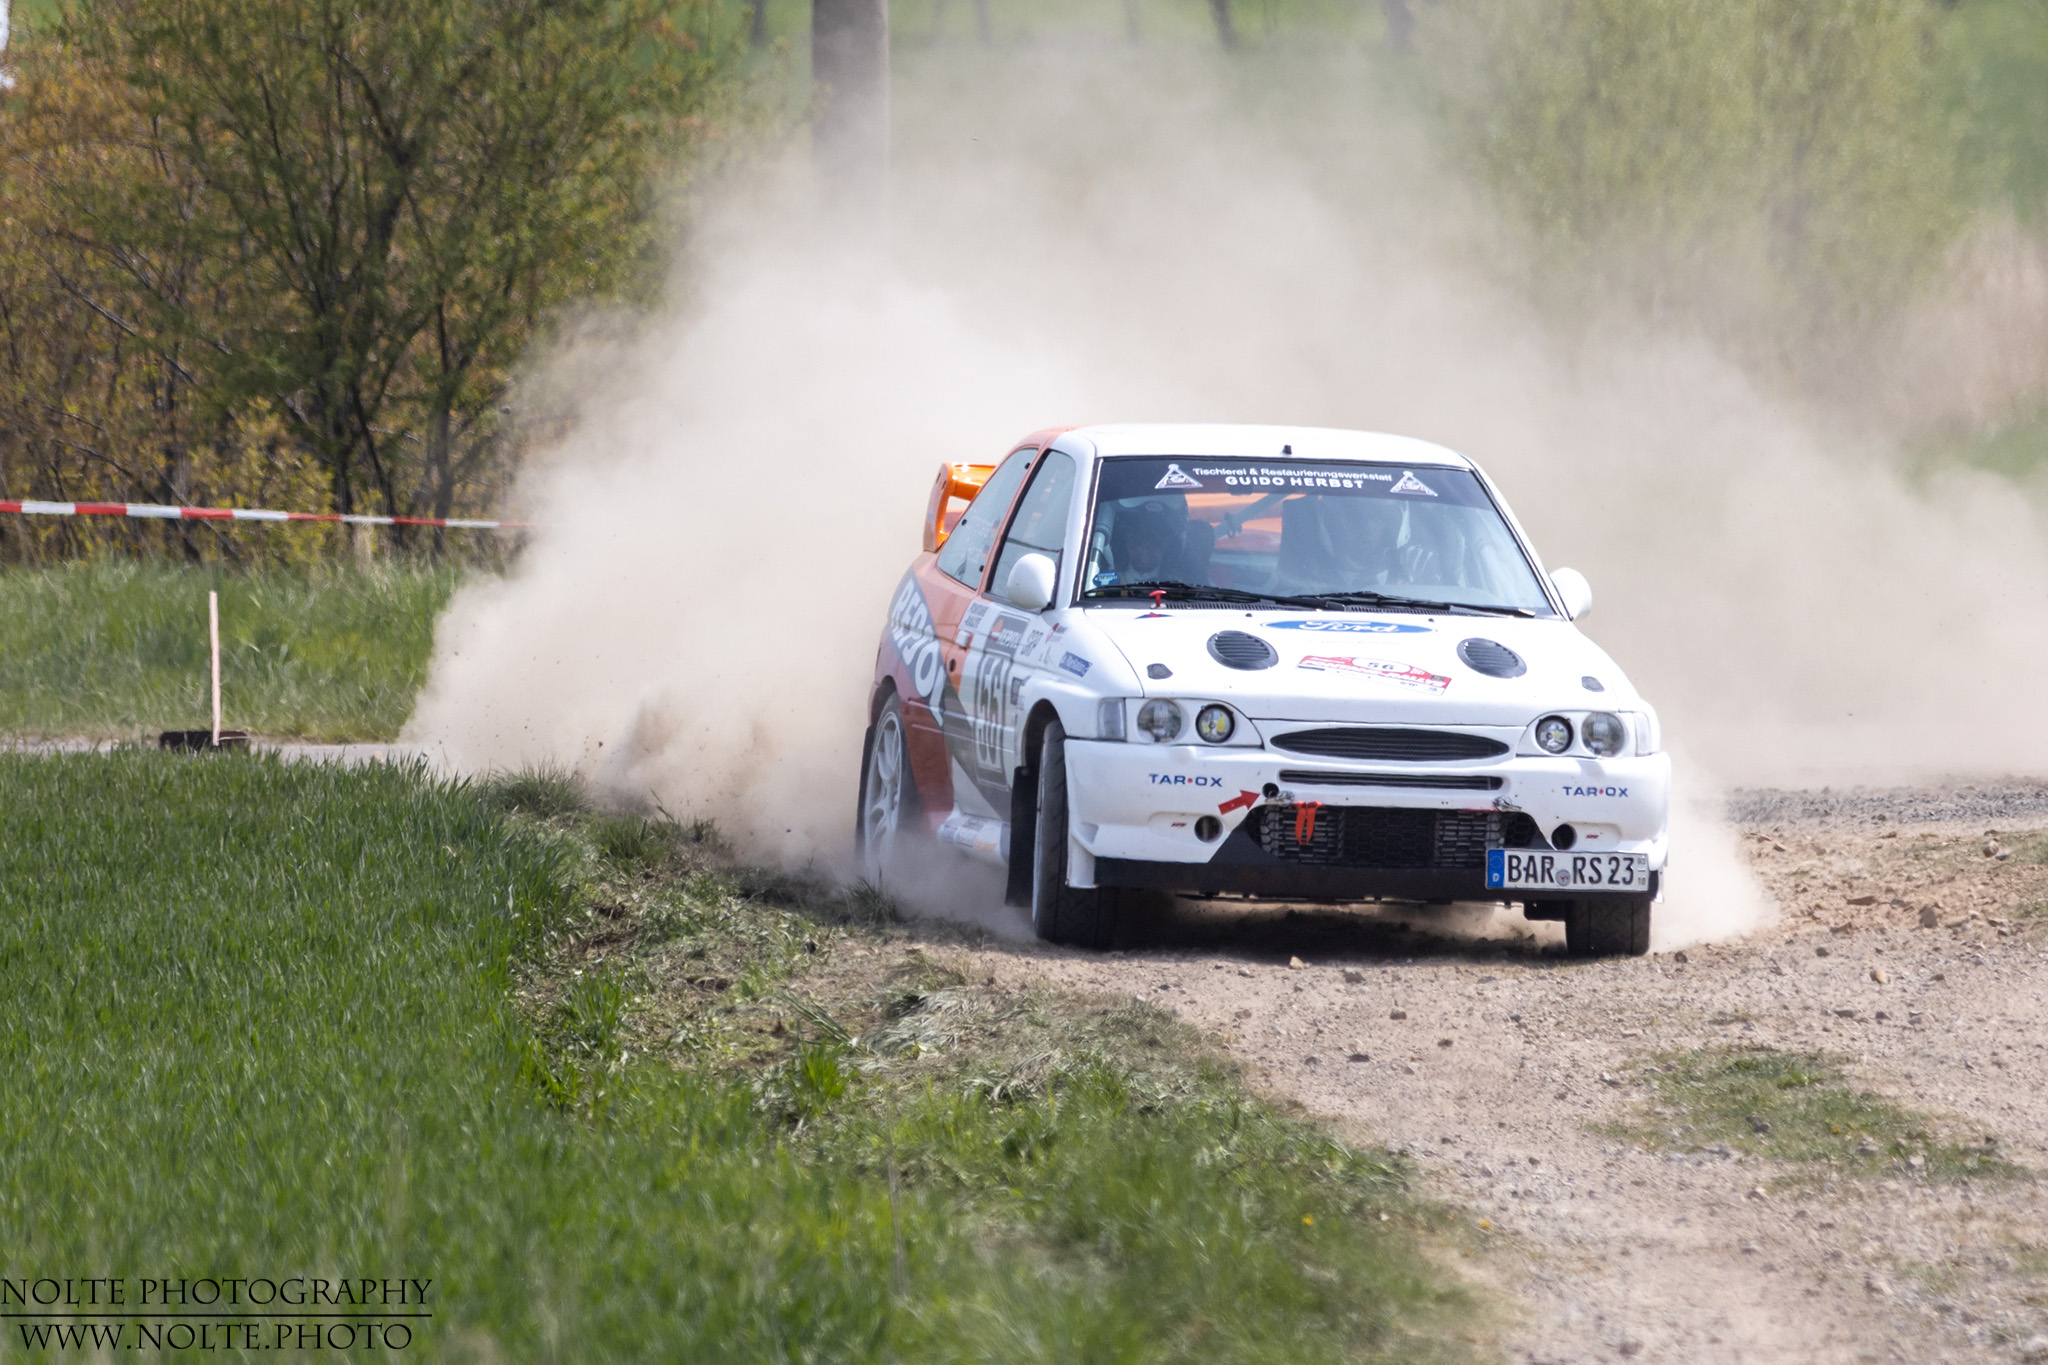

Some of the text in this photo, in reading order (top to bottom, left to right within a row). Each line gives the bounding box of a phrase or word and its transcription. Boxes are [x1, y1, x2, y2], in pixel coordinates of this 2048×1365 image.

[1192, 467, 1393, 482] Tischlerei & Restaurierungswerkstatt
[1225, 476, 1364, 489] GUIDO HERBST
[1298, 620, 1400, 633] Ford
[891, 577, 947, 728] REPSOL
[1368, 661, 1394, 670] 56
[1507, 854, 1555, 884] BAR
[1573, 856, 1602, 884] RS
[1607, 856, 1635, 885] 23
